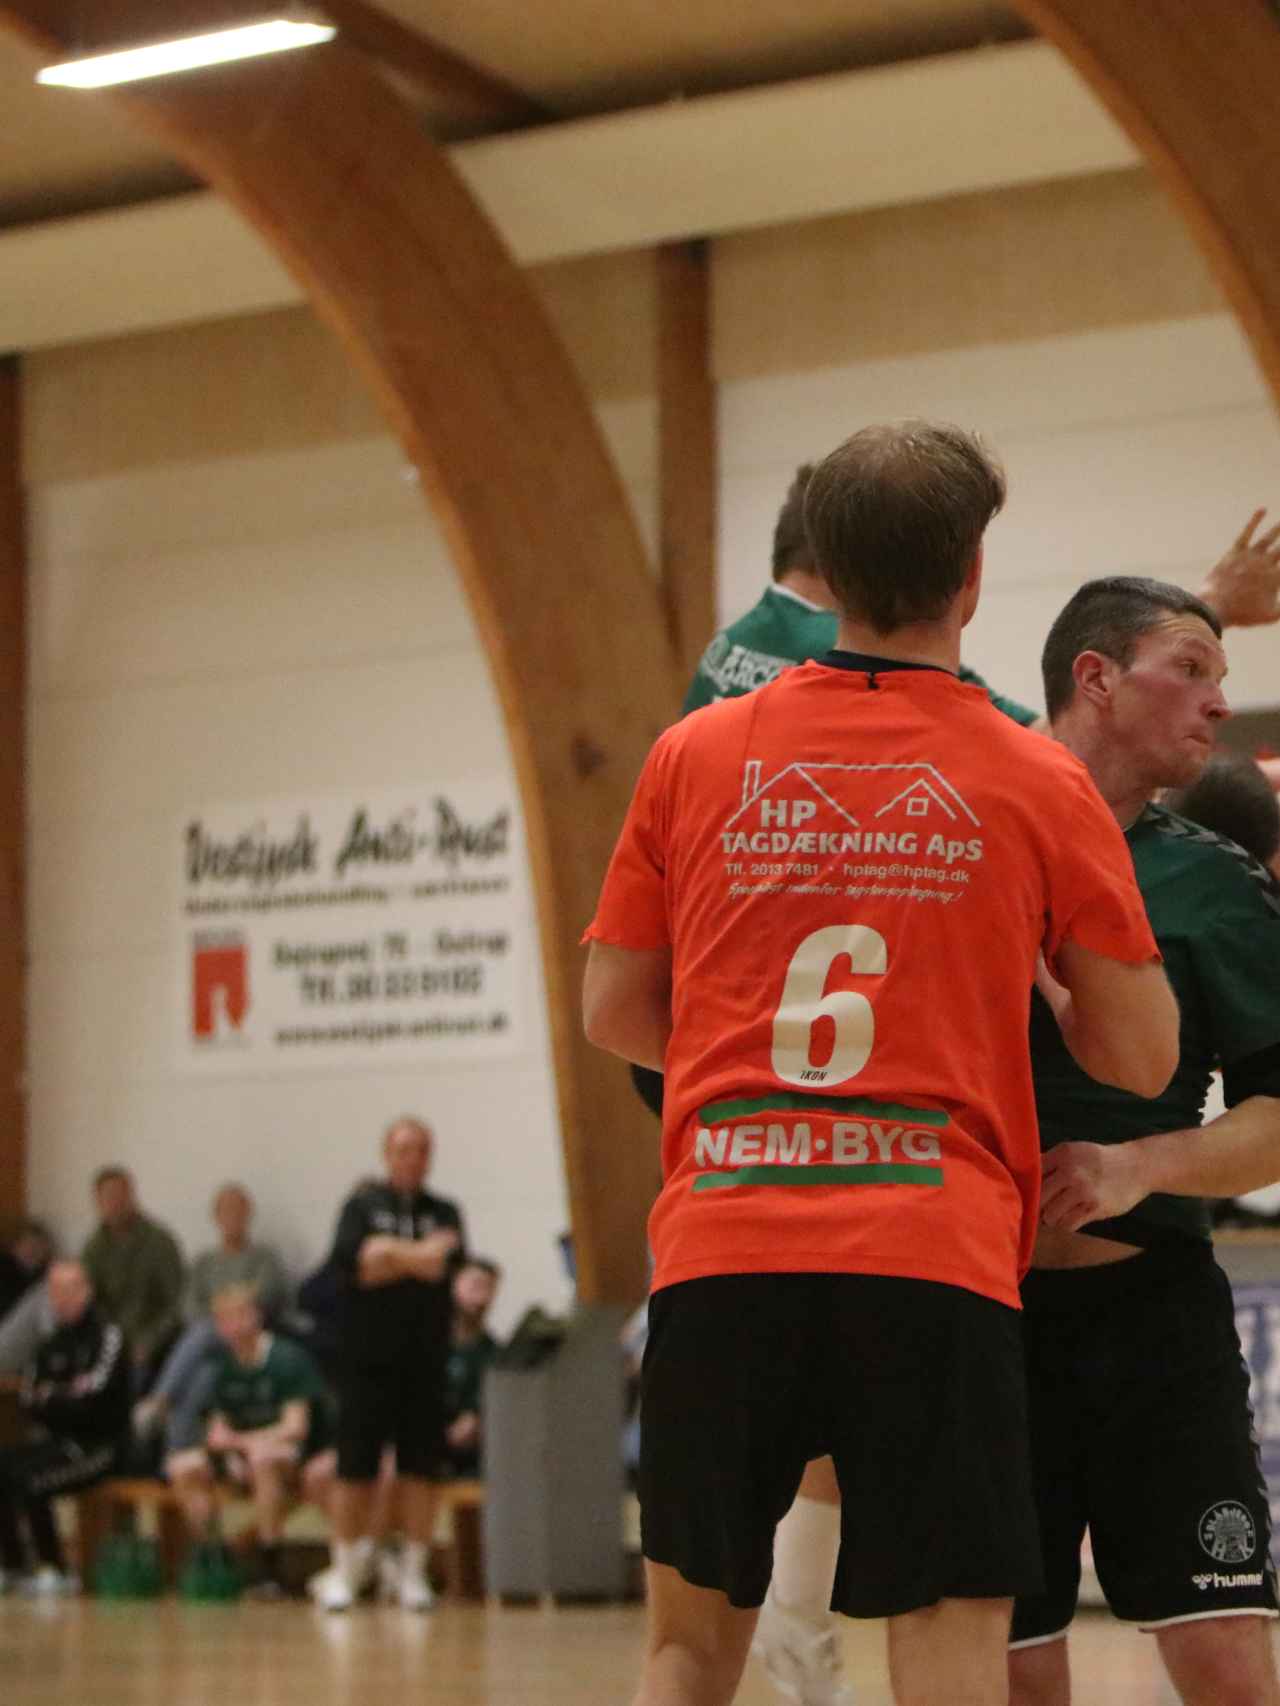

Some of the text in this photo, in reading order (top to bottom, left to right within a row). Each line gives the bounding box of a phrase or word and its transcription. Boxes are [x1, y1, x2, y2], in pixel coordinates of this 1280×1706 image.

[760, 800, 817, 828] HP
[720, 832, 984, 864] TAGDÆKNING ApS
[771, 924, 889, 1088] 6
